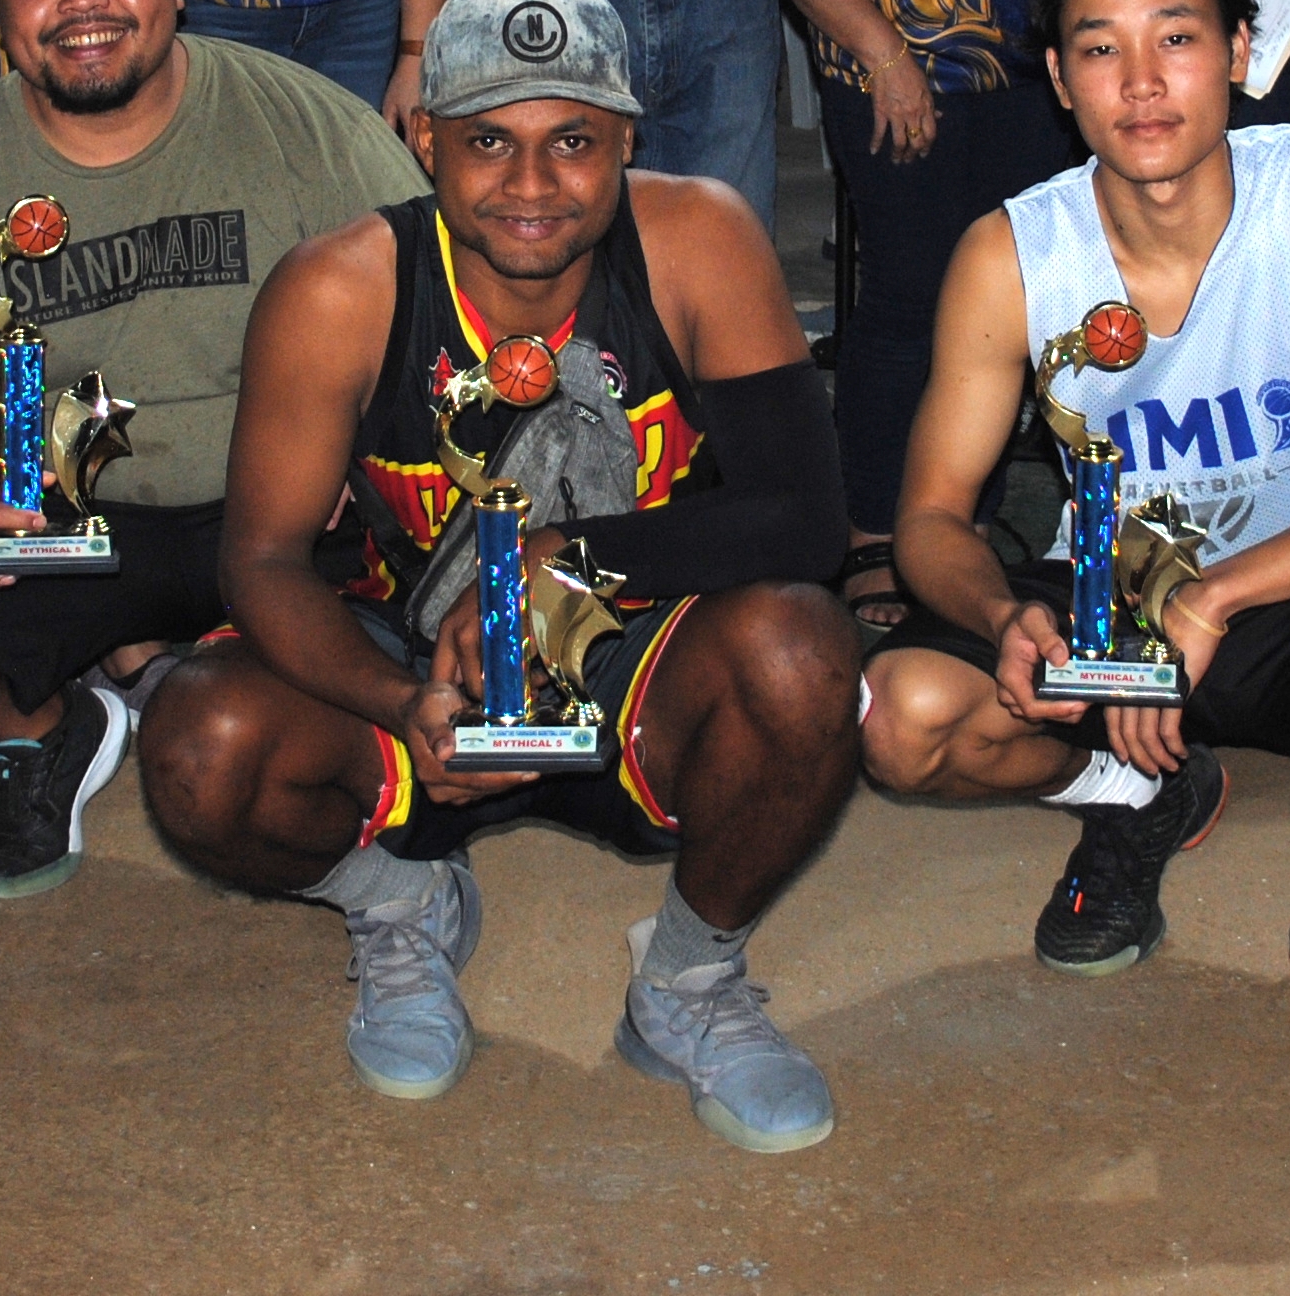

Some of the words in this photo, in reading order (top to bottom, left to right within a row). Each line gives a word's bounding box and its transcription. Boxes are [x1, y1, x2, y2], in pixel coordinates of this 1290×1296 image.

[527, 13, 545, 41] N
[193, 272, 241, 283] PRIDE
[19, 546, 73, 554] MYTHICAL
[1080, 672, 1136, 682] MYTHICAL
[492, 739, 553, 748] MYTHICAL
[556, 739, 563, 748] 5
